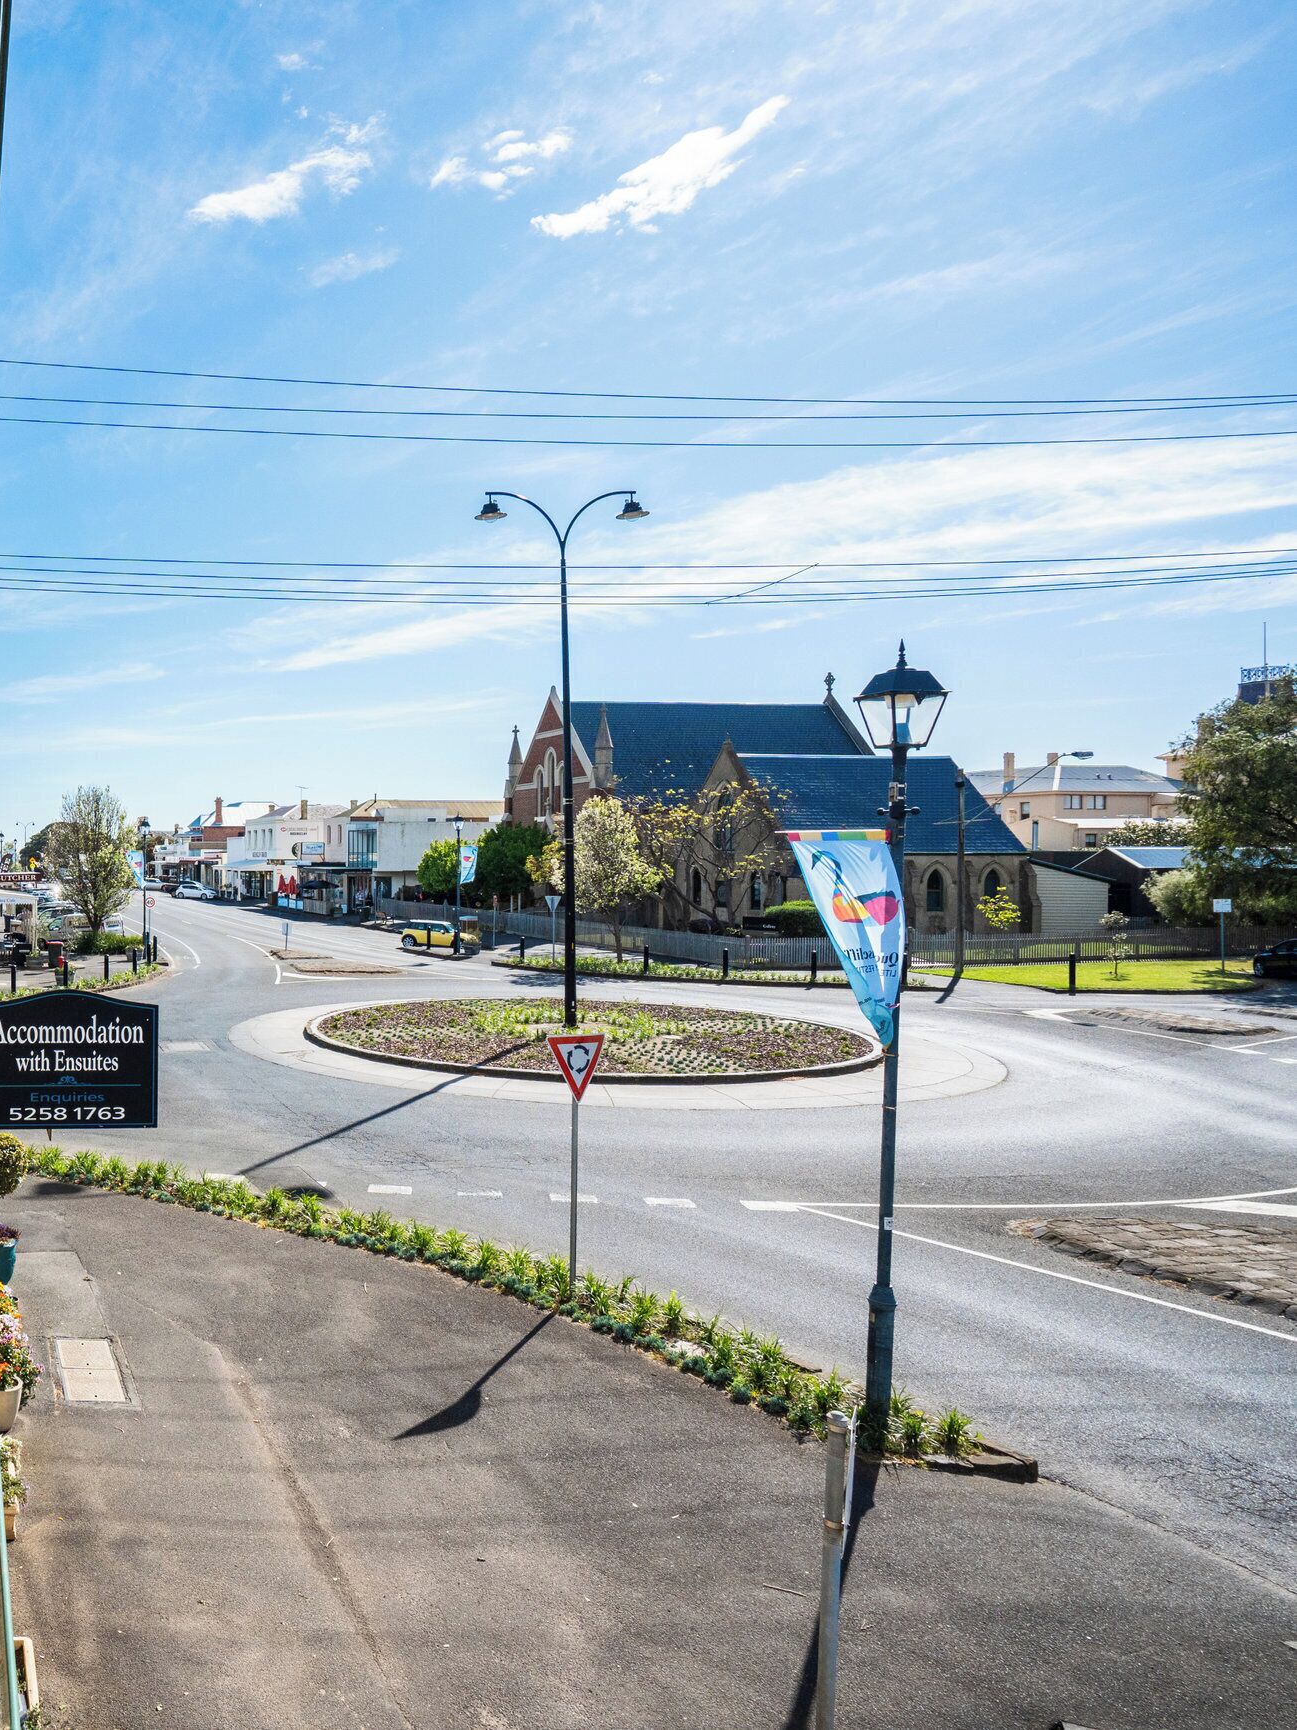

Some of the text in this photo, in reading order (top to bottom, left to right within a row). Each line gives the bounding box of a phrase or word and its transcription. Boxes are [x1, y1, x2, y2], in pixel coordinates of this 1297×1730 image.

[16, 1048, 119, 1072] with Ensuites
[30, 1092, 105, 1104] Enquiries
[9, 1106, 126, 1121] 5258 1763
